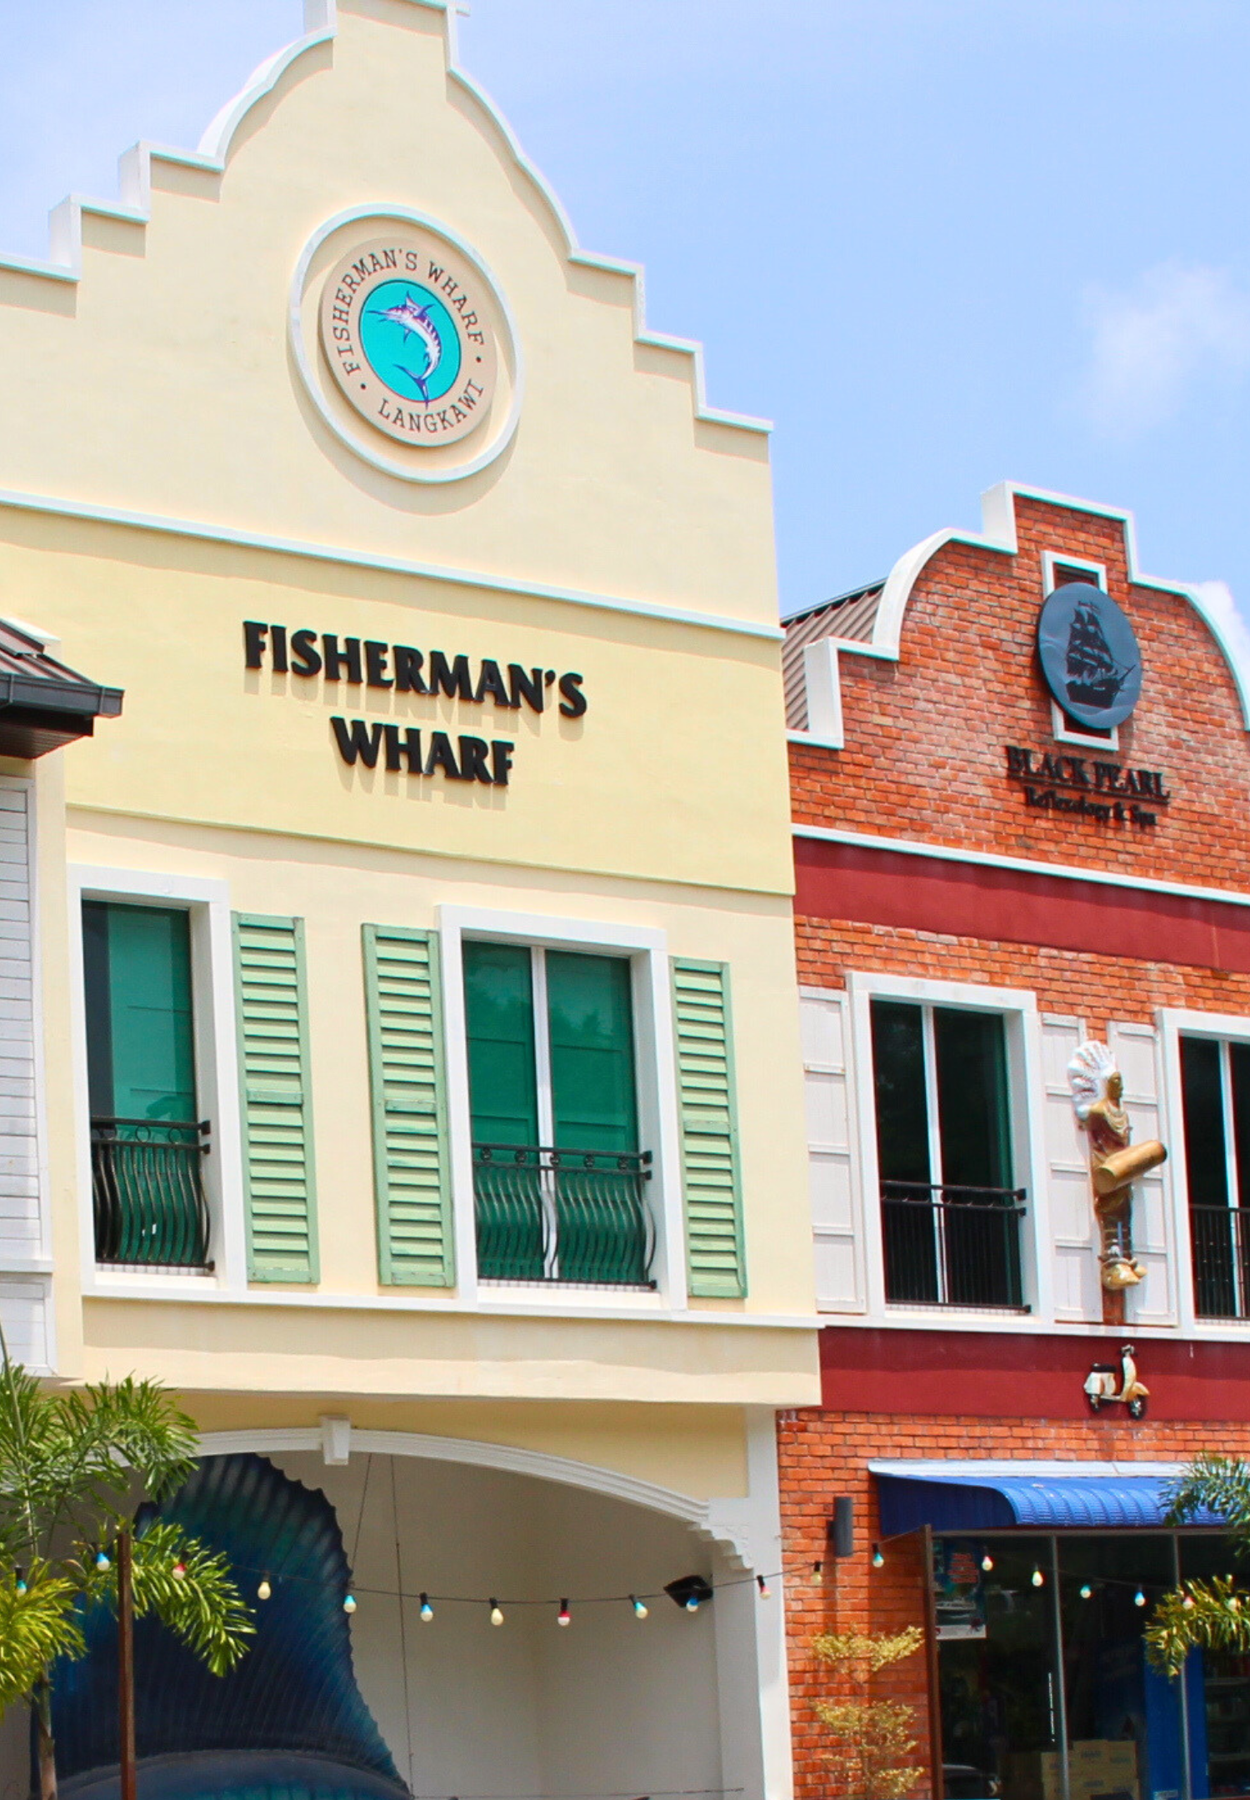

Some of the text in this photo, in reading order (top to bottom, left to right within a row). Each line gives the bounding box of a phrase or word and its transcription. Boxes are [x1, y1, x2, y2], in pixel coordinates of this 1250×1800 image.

[332, 248, 485, 376] FISHERMAN'S WHARF
[378, 378, 484, 433] LANGKAWI
[243, 620, 588, 719] FISHERMAN'S
[329, 716, 515, 786] WHARF
[1006, 745, 1170, 798] BLACK PEARL
[1130, 804, 1157, 829] Spa
